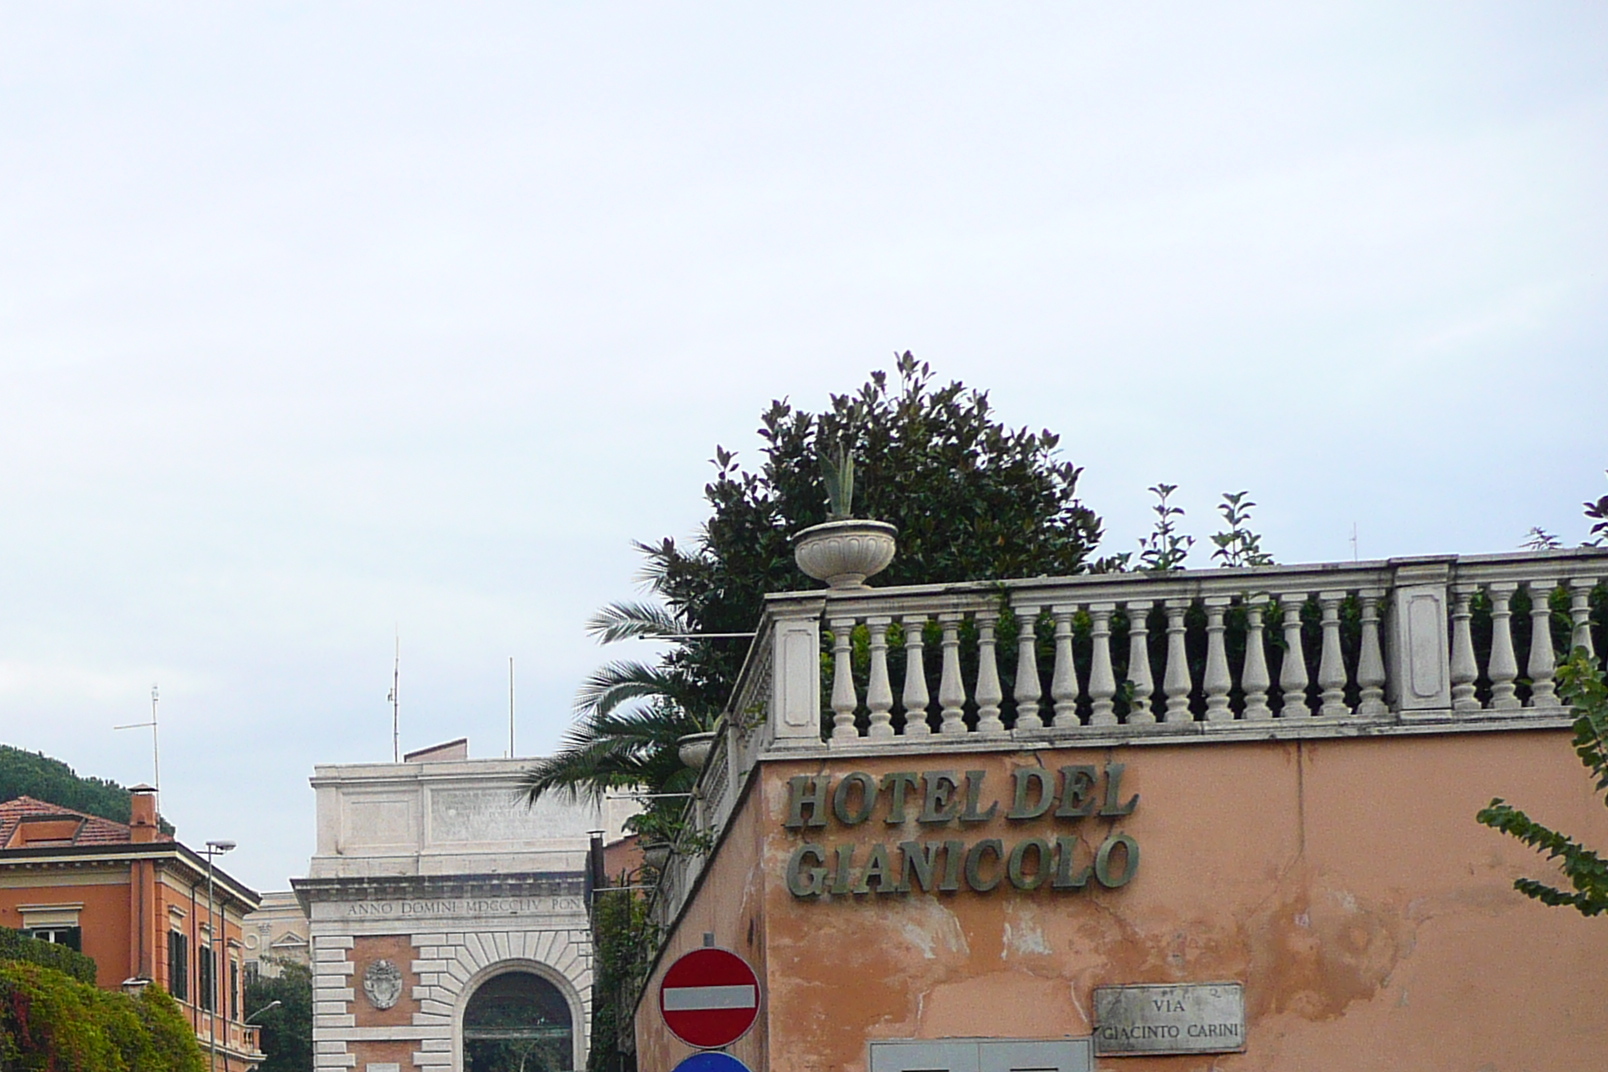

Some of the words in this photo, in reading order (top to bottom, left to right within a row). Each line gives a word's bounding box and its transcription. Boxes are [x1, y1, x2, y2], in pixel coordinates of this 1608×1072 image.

[784, 770, 998, 828] HOTEL
[1006, 763, 1140, 820] DEL
[786, 833, 1141, 898] GIANICOLO
[348, 902, 393, 916] ANNO
[401, 901, 457, 915] DOMINI
[1152, 1000, 1185, 1013] VIA
[1103, 1025, 1180, 1040] GIACINTO
[1187, 1024, 1238, 1037] CARINI
